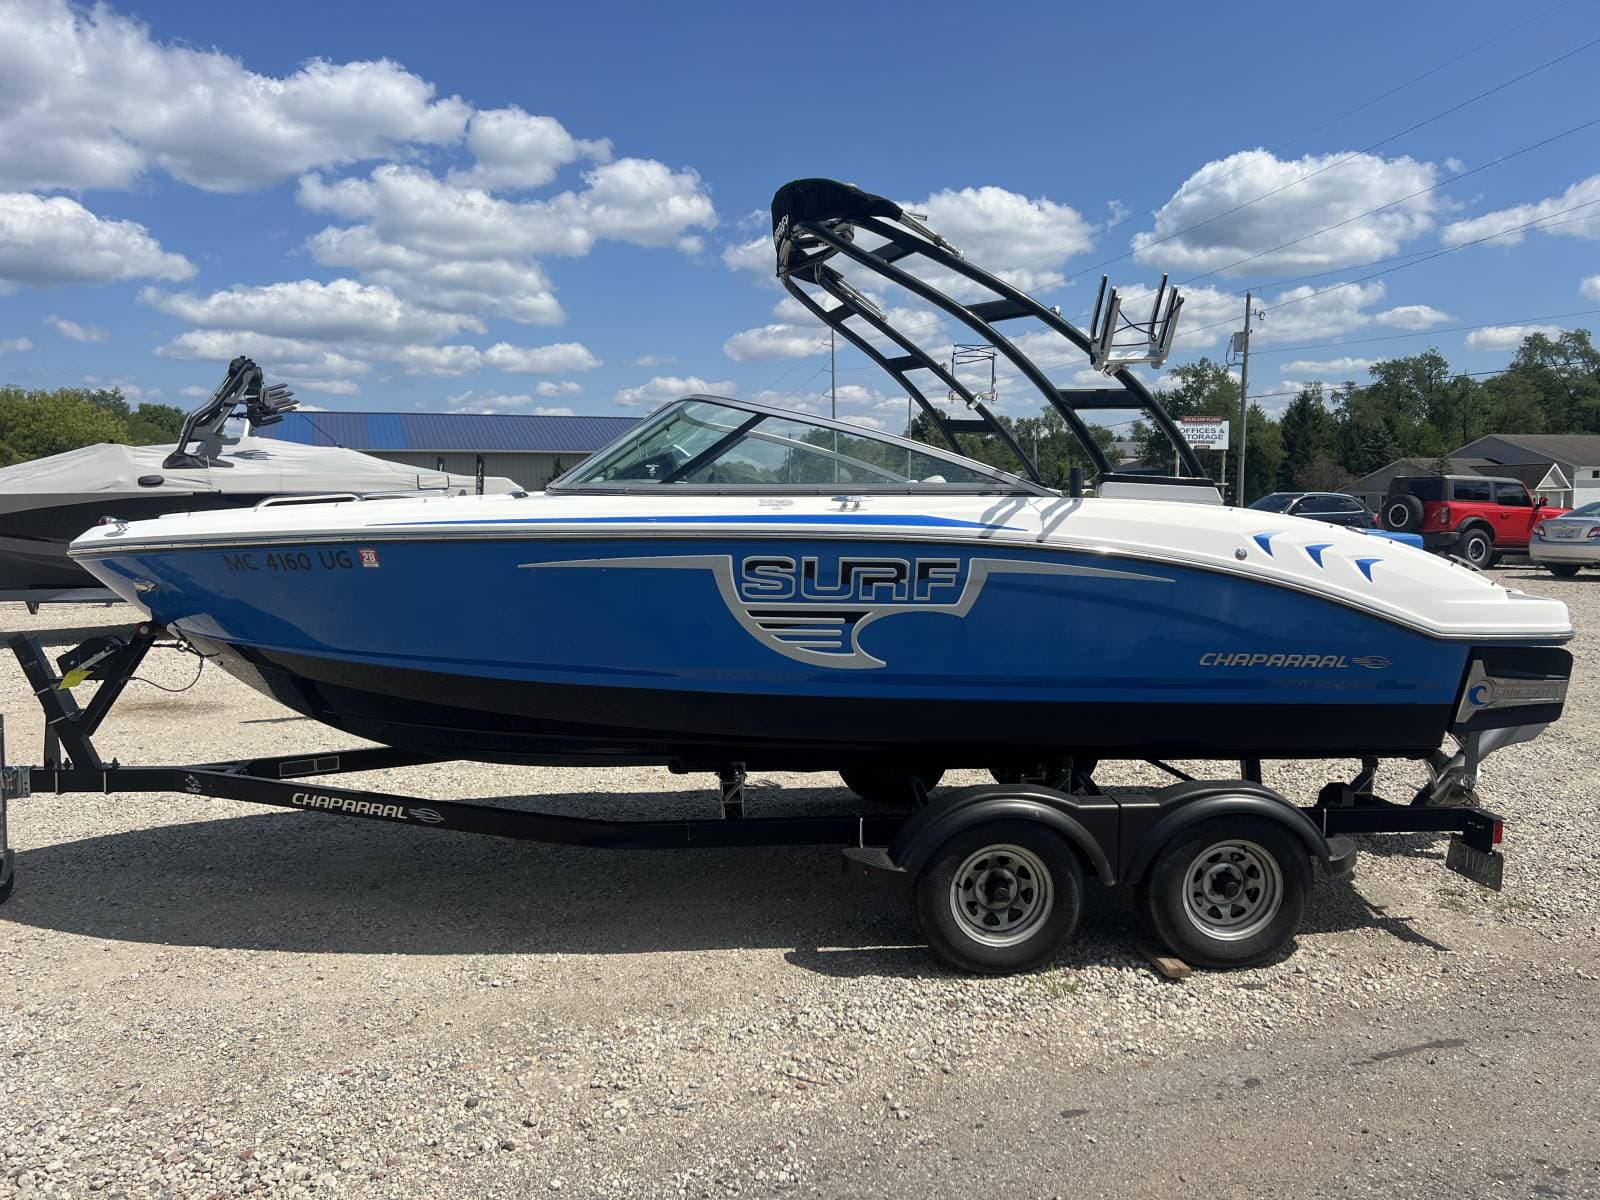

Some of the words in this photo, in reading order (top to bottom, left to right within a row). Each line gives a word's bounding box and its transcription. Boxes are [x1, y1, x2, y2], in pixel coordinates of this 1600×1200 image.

[224, 554, 258, 571] MC
[266, 553, 312, 571] 4160
[318, 550, 353, 570] UG
[362, 552, 376, 563] 28
[741, 556, 961, 601] SURF
[1199, 652, 1349, 669] CHAPARRAL
[292, 792, 409, 819] CHAPARRAL
